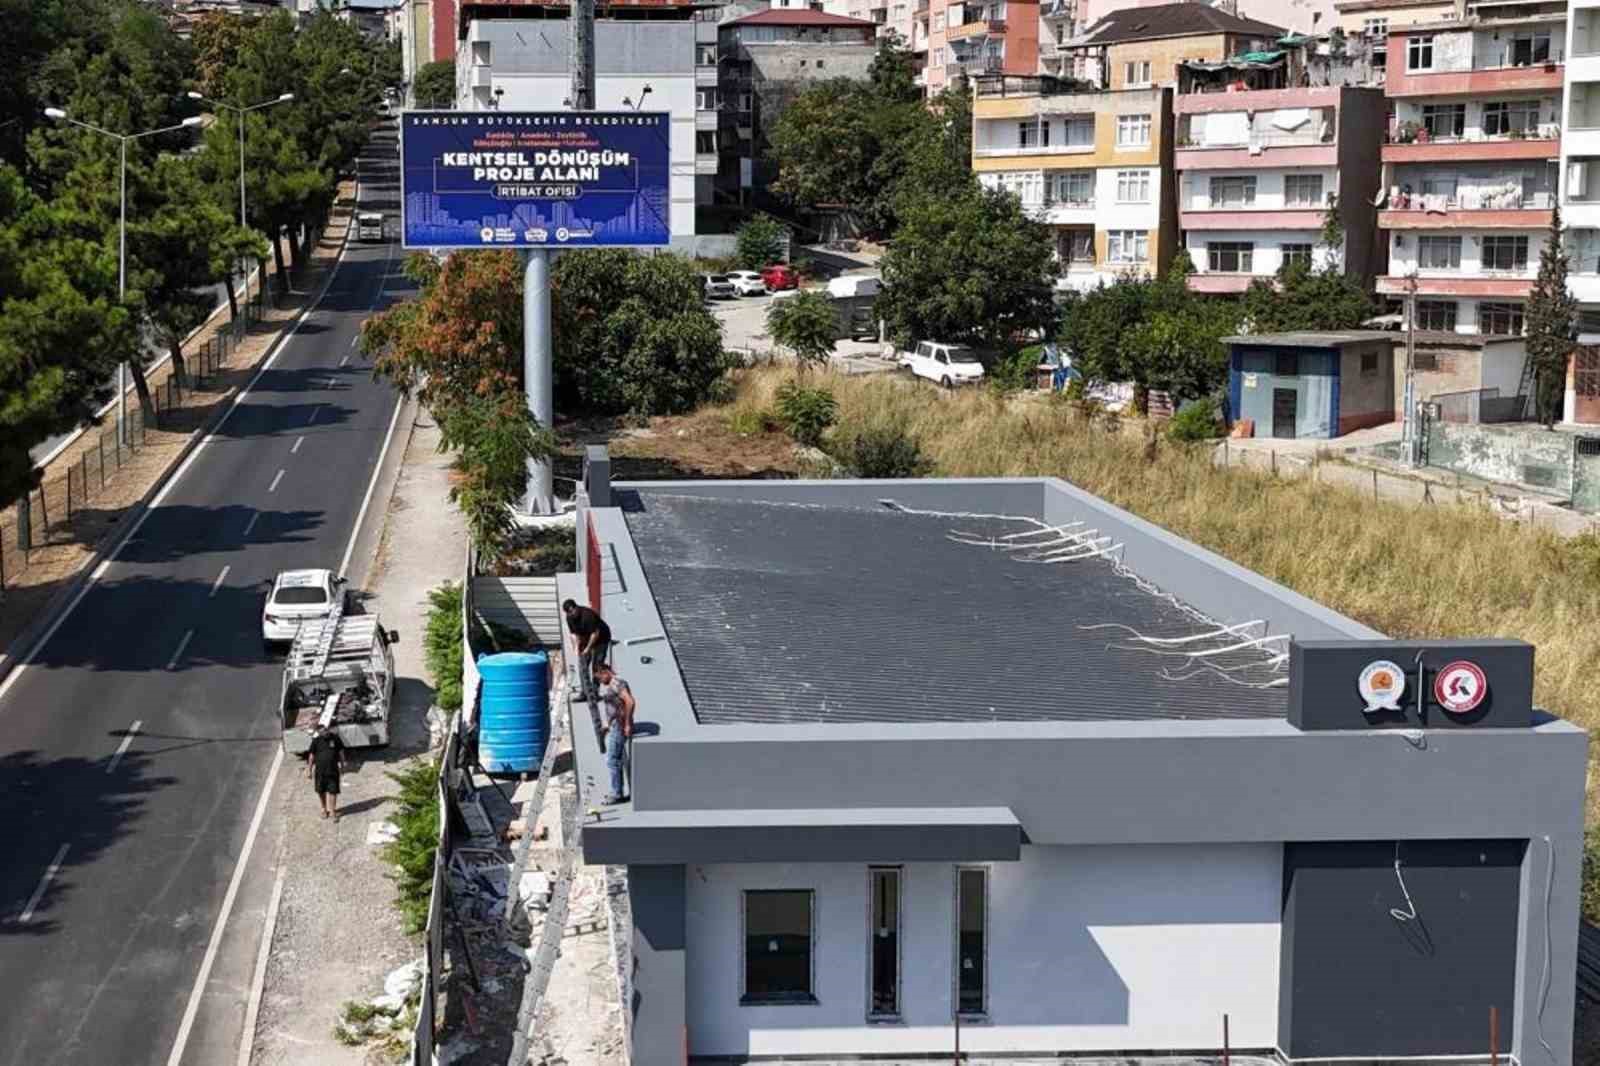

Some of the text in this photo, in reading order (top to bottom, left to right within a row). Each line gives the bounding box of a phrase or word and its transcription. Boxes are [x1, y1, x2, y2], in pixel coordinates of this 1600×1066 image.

[443, 149, 631, 169] KENTSEL DÖNÜŞÜM
[473, 166, 600, 181] PROJE ALANI
[497, 185, 577, 197] İRTİBAT OFİSİ
